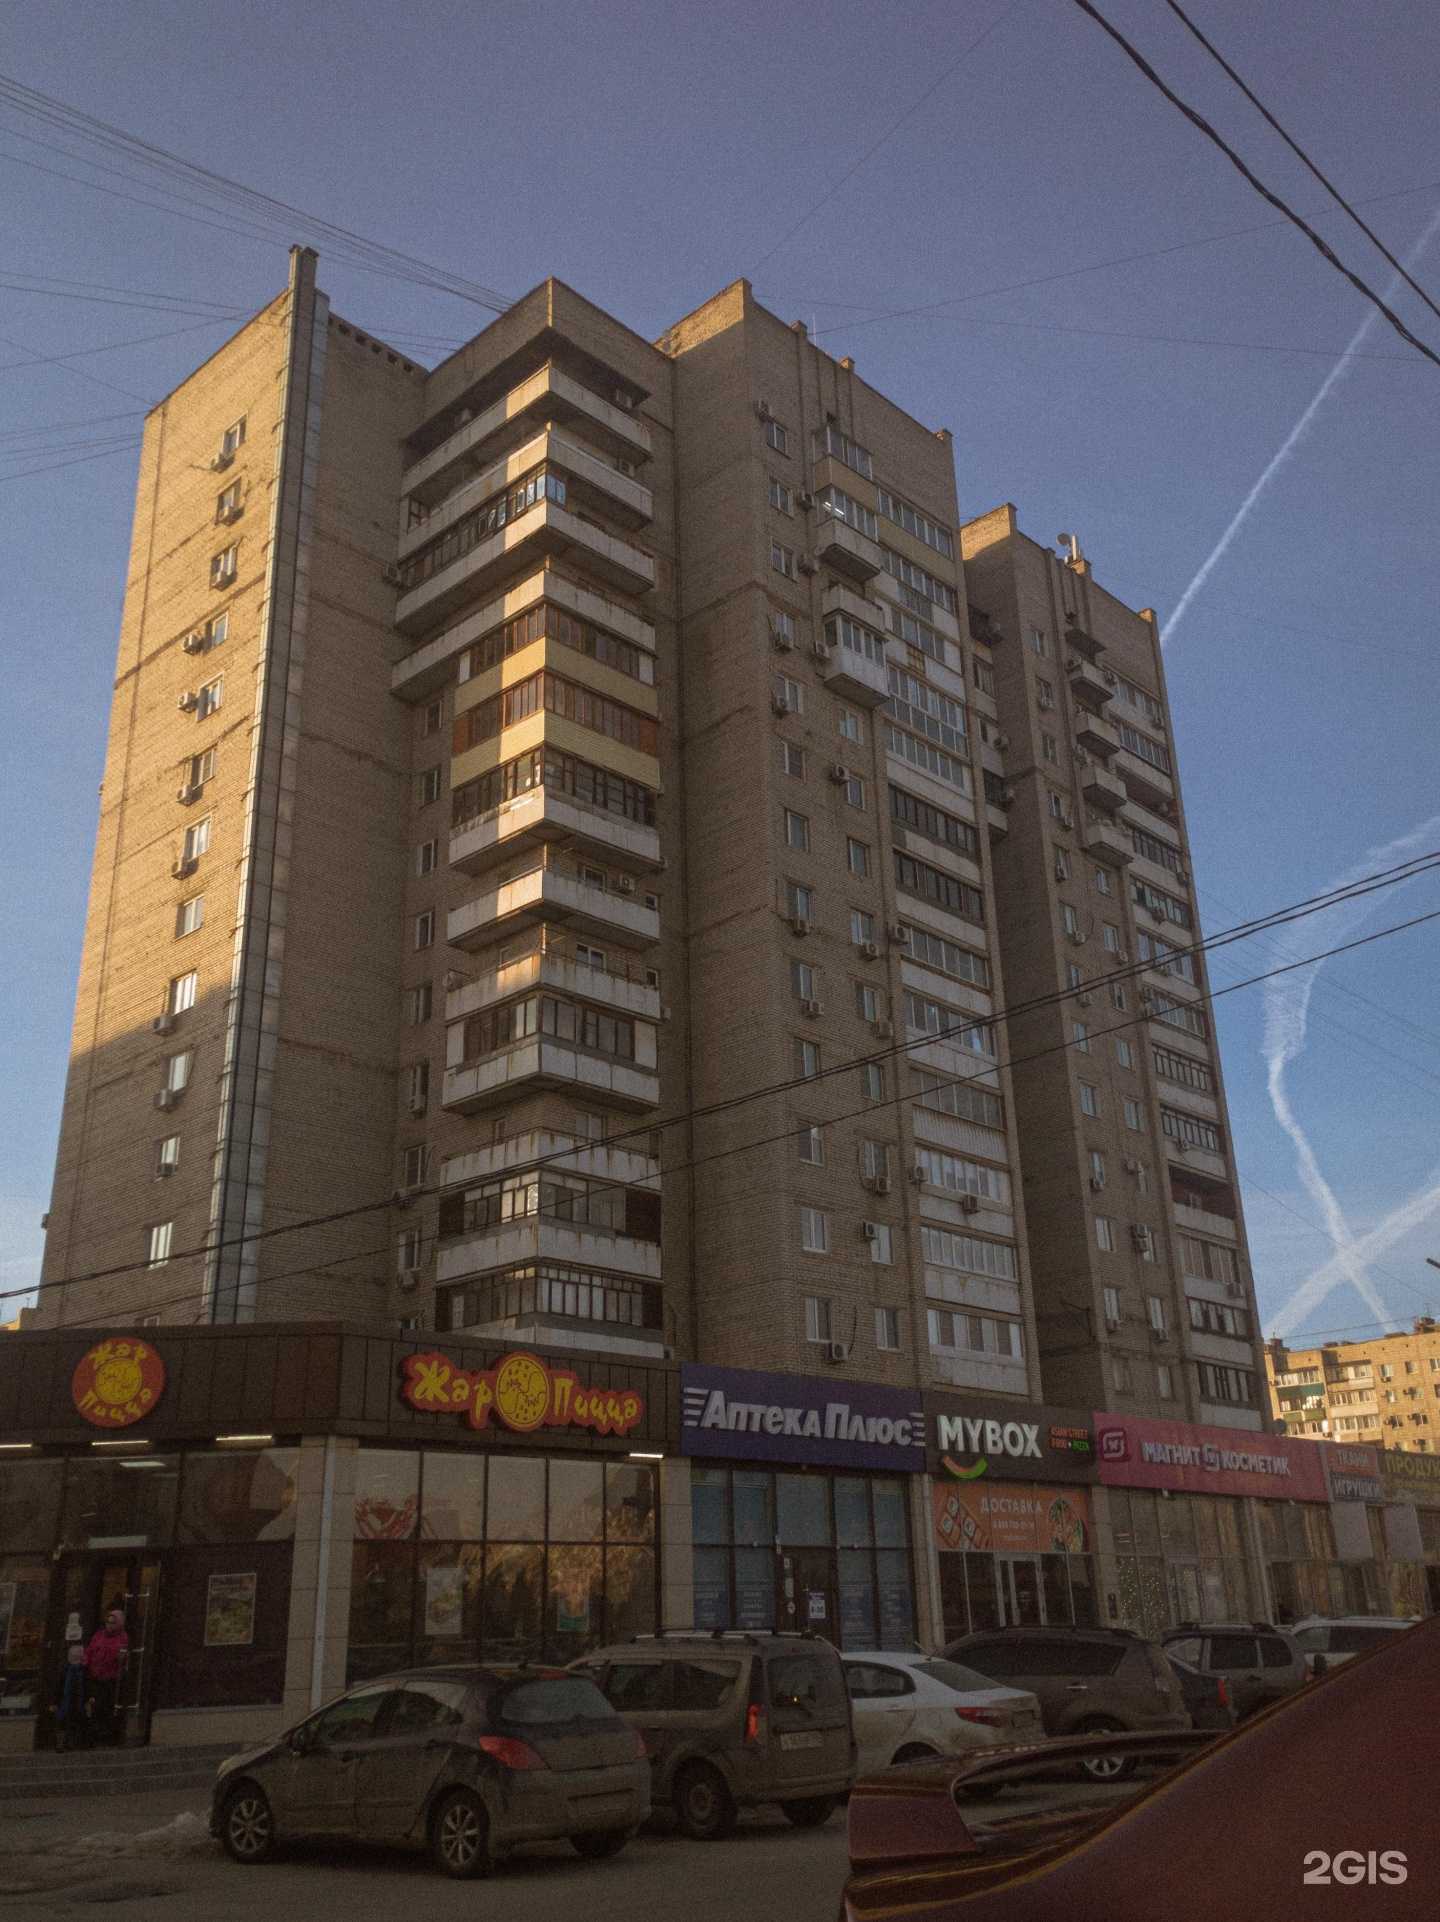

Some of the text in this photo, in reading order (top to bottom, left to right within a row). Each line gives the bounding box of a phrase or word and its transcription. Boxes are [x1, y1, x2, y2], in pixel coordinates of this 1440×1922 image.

[88, 1341, 148, 1370] Жар
[77, 1388, 152, 1423] Пицца
[413, 1359, 639, 1426] Жар Пицца
[823, 1402, 914, 1447] Плюс
[936, 1414, 1043, 1458] MYBOX
[1140, 1440, 1291, 1476] МАГНИТ КОСМЕТИК
[979, 1496, 1043, 1514] ДОСТАВКА
